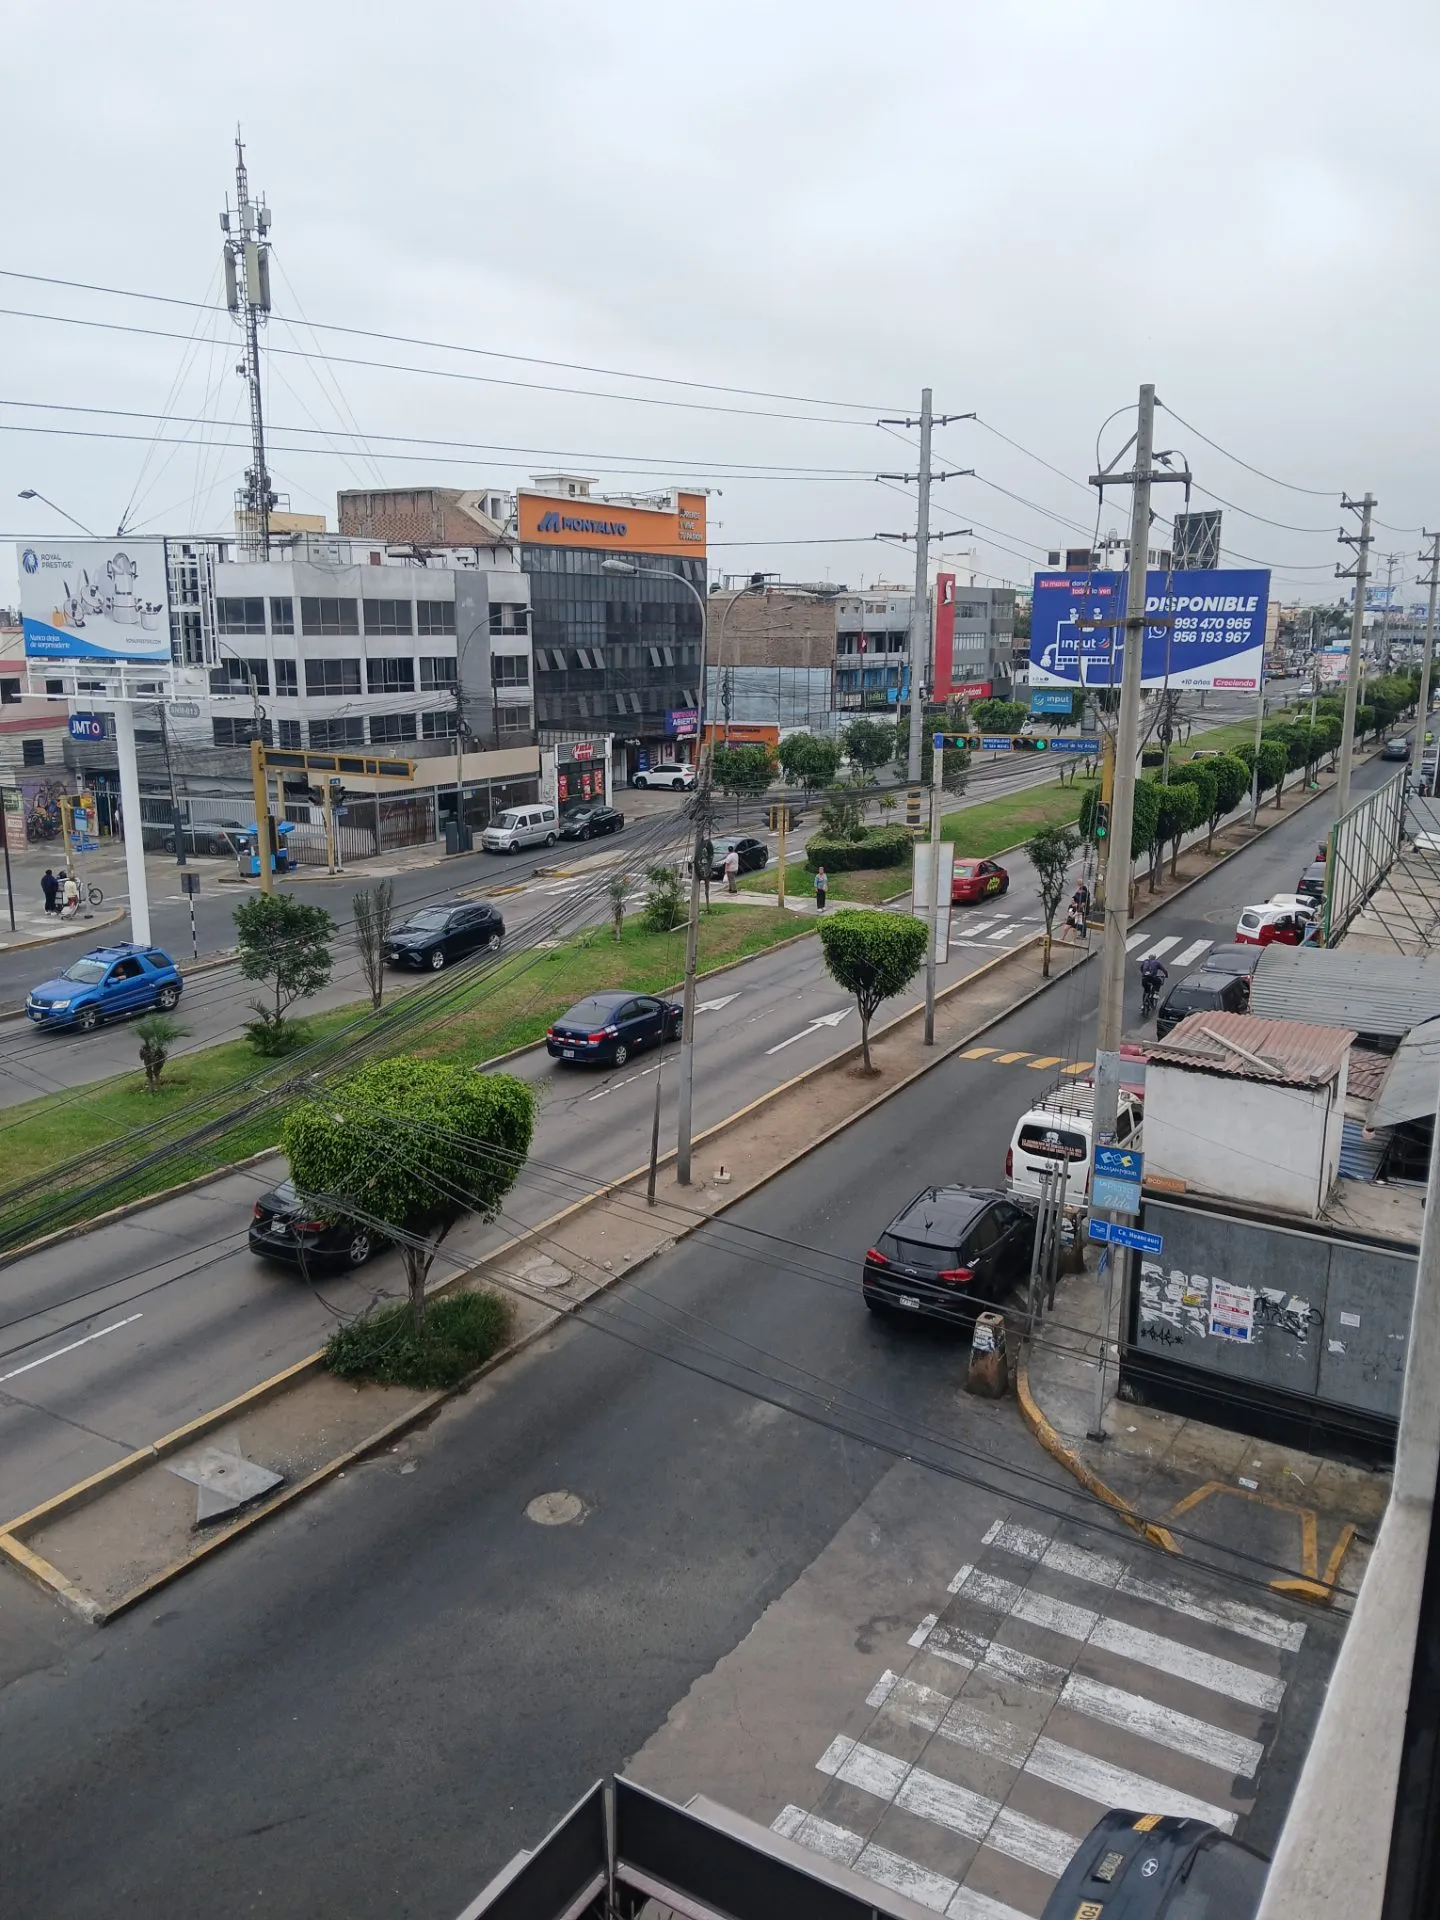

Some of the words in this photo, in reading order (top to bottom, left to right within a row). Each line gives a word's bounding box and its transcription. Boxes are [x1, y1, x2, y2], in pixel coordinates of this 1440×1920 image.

[562, 516, 627, 536] MONTALVO
[1145, 597, 1258, 612] DISPONIBLE
[1174, 618, 1198, 629] 993
[1200, 618, 1224, 629] 470
[1226, 618, 1252, 629] 965
[1173, 632, 1197, 643] 956
[1200, 632, 1223, 643] 193
[1225, 632, 1250, 643] 967
[1061, 638, 1096, 651] input
[1216, 679, 1254, 687] Creciendo
